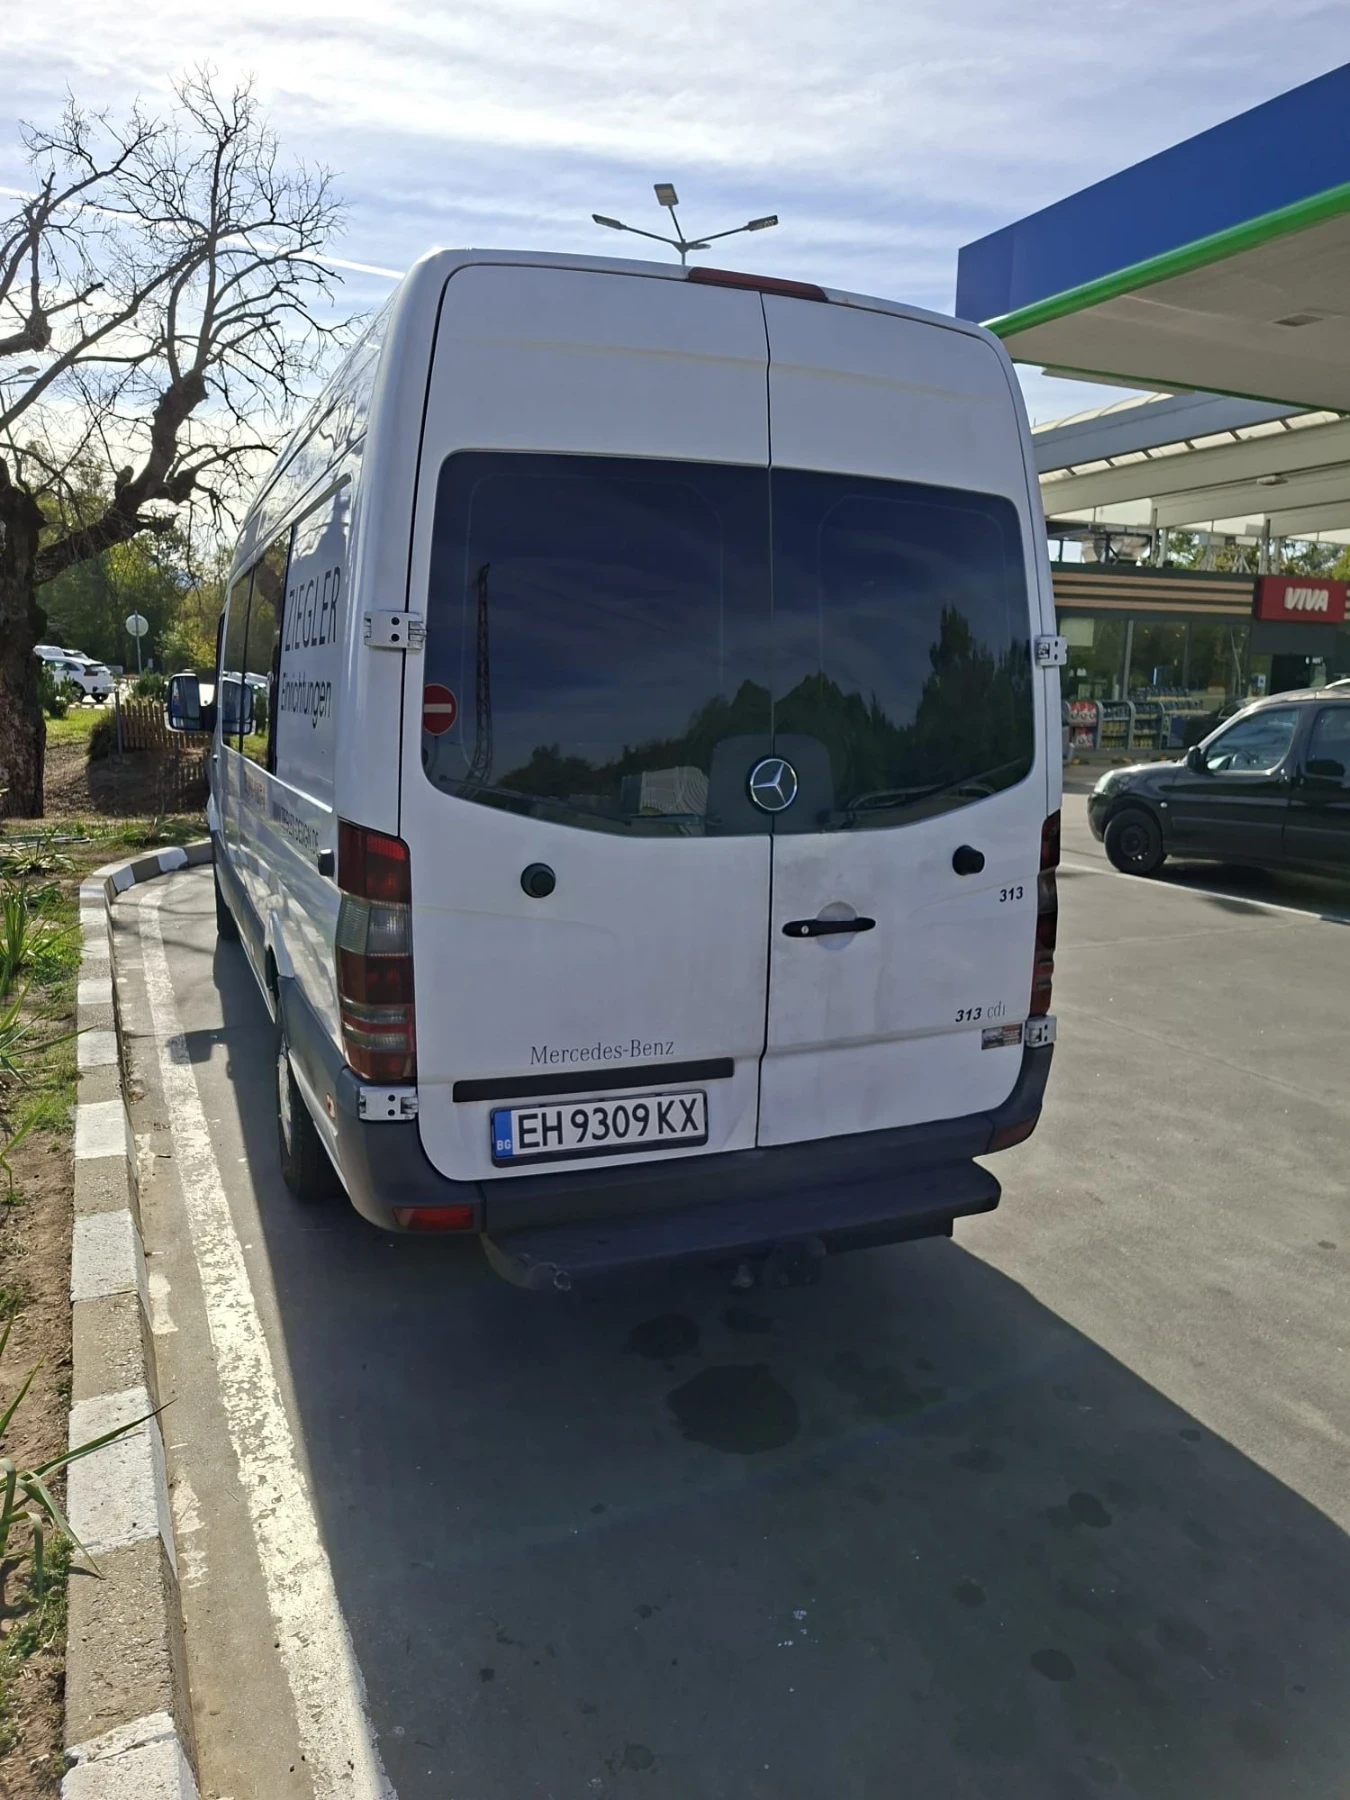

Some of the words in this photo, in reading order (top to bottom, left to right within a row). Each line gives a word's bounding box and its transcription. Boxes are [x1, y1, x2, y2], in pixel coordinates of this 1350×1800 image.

[285, 566, 341, 651] ZIEGLER
[1284, 587, 1329, 612] VIVA
[999, 886, 1024, 902] 313
[955, 1007, 982, 1022] 313
[987, 1001, 1006, 1019] cdi
[530, 1039, 675, 1065] Mercedes-Benz
[518, 1110, 563, 1149] EH
[570, 1103, 650, 1143] 9309
[657, 1098, 699, 1134] KX
[496, 1139, 511, 1151] BG
